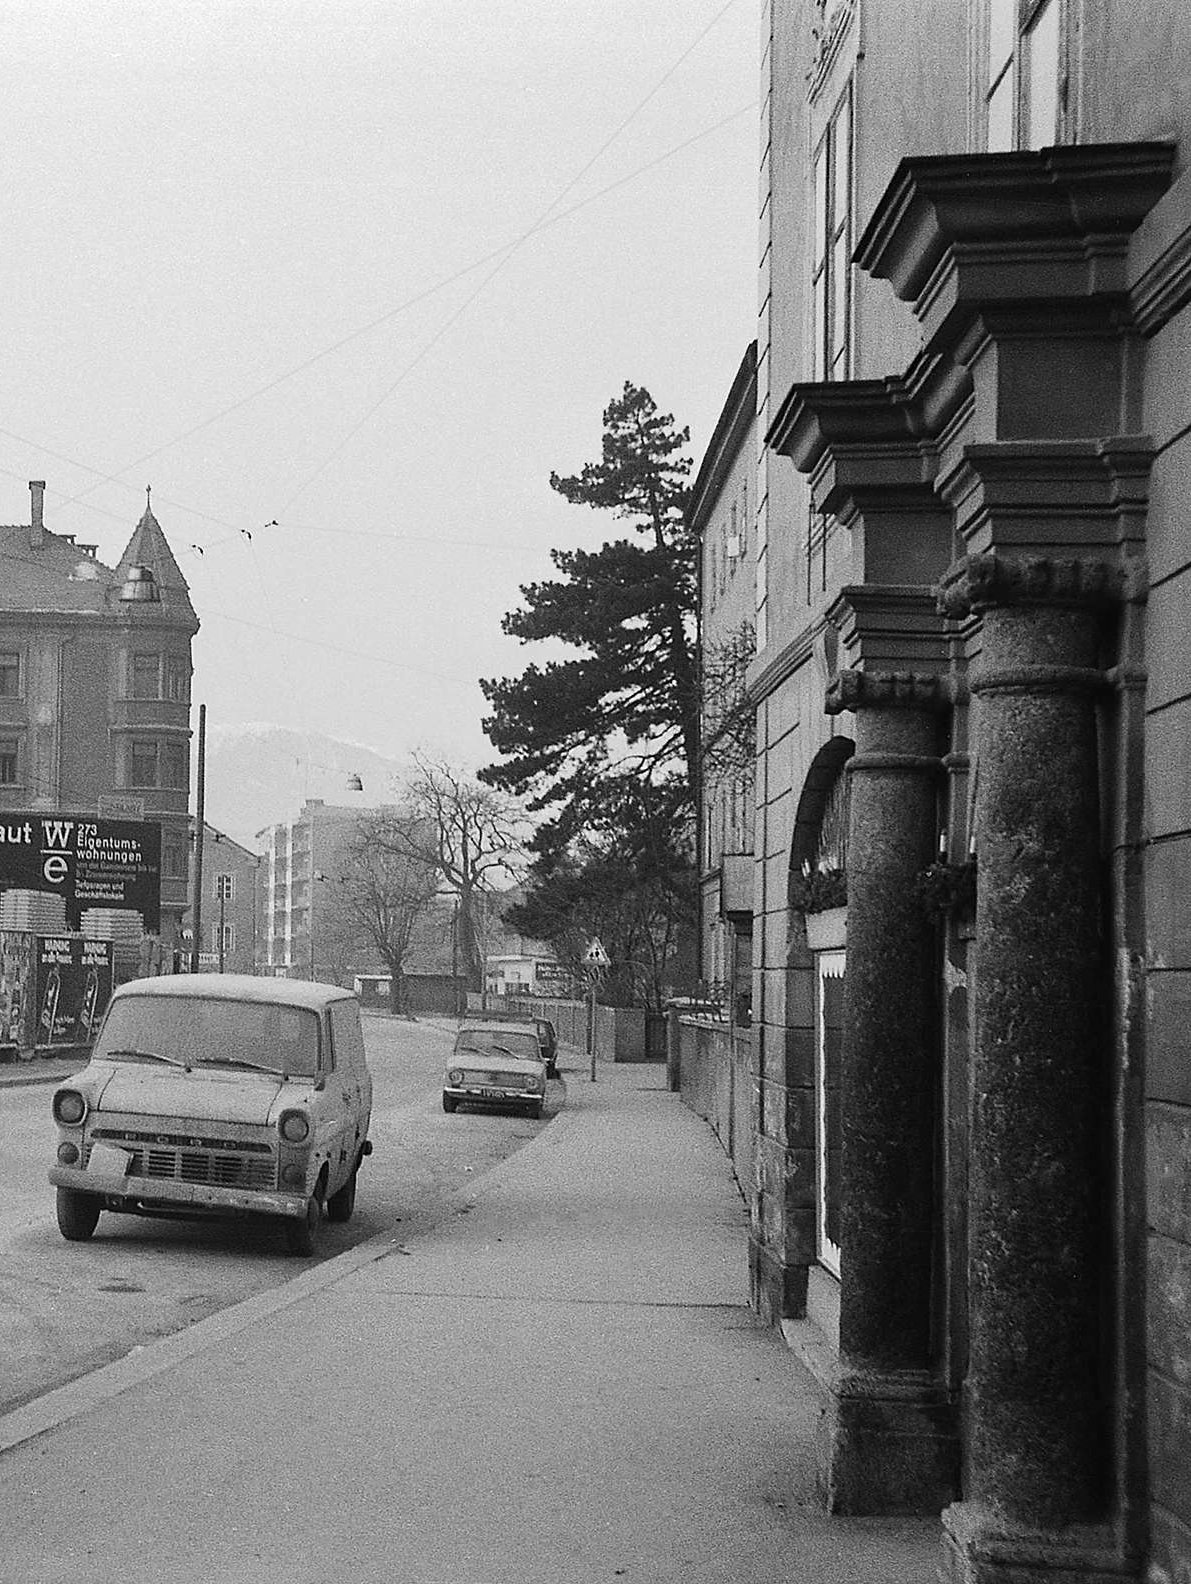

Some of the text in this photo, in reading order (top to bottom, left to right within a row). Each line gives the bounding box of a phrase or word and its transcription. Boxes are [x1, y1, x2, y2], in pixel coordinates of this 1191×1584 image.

[41, 820, 74, 848] W
[77, 823, 97, 836] 273
[76, 848, 142, 863] wohnungen
[43, 855, 69, 884] e
